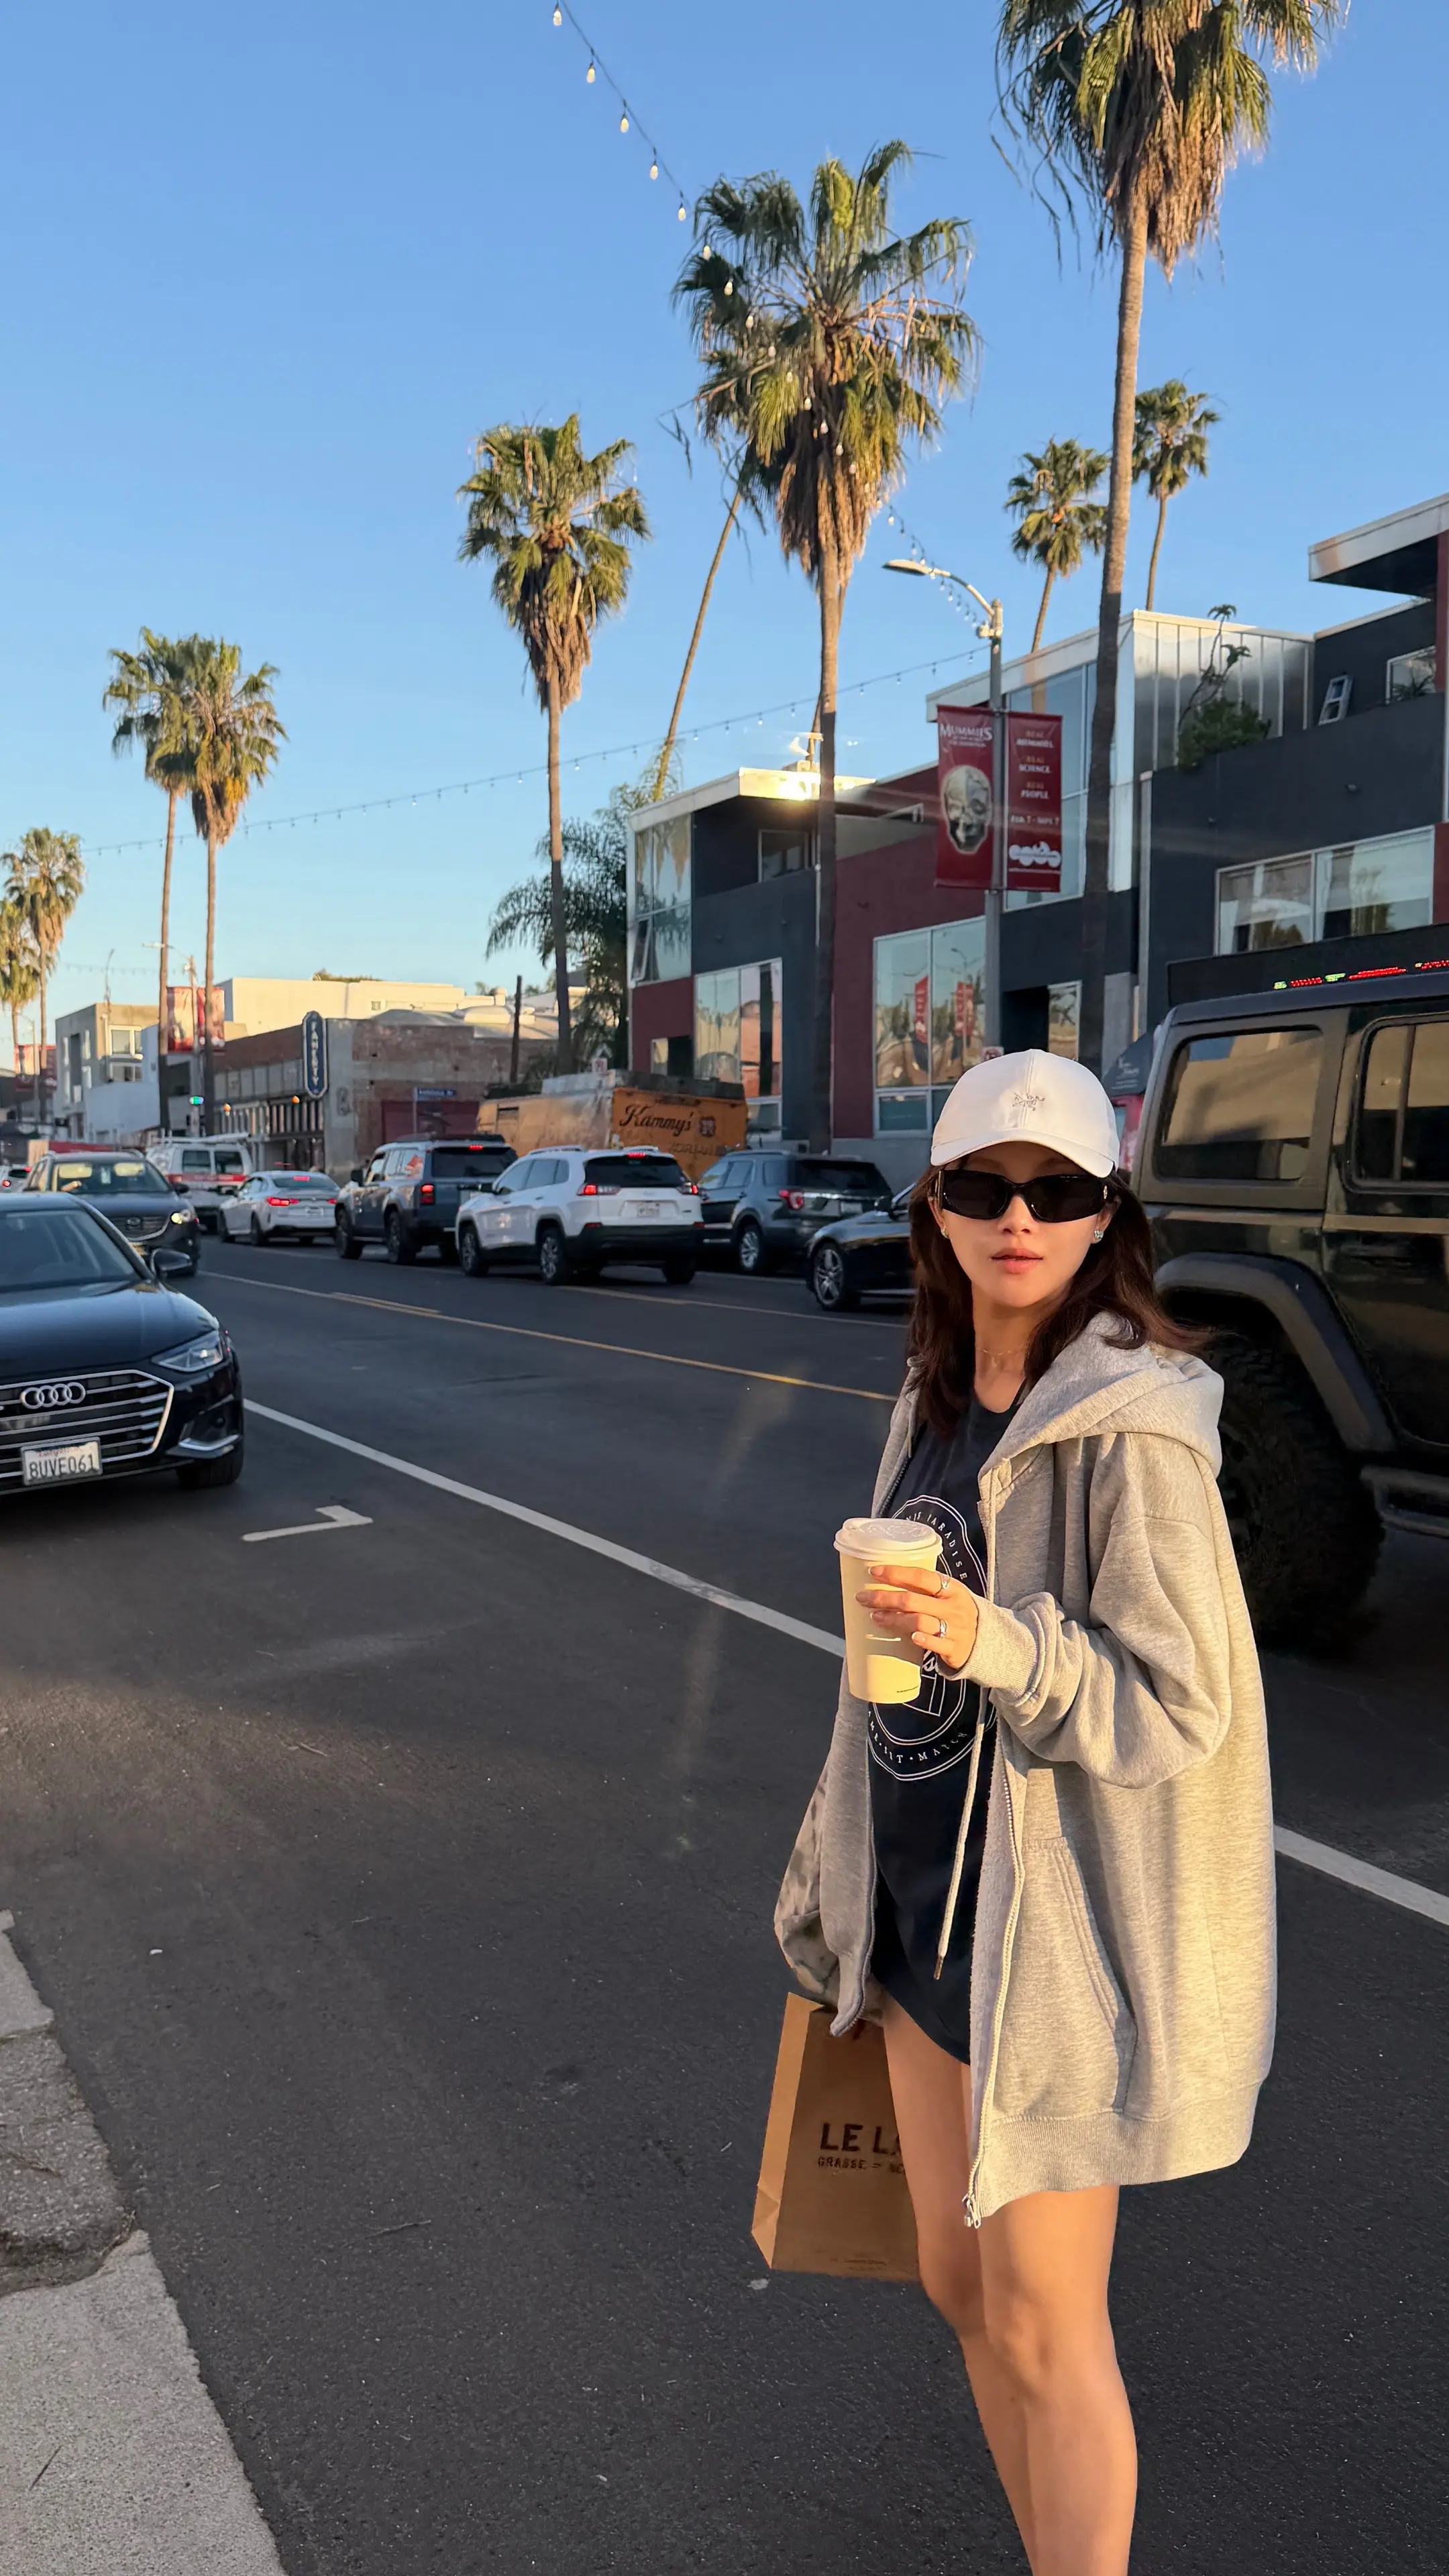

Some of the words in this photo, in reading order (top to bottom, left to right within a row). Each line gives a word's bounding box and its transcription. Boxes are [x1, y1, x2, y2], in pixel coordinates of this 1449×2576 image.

[619, 1103, 694, 1136] Kammy's
[30, 1454, 98, 1480] 8UVE061
[820, 2123, 863, 2151] LE
